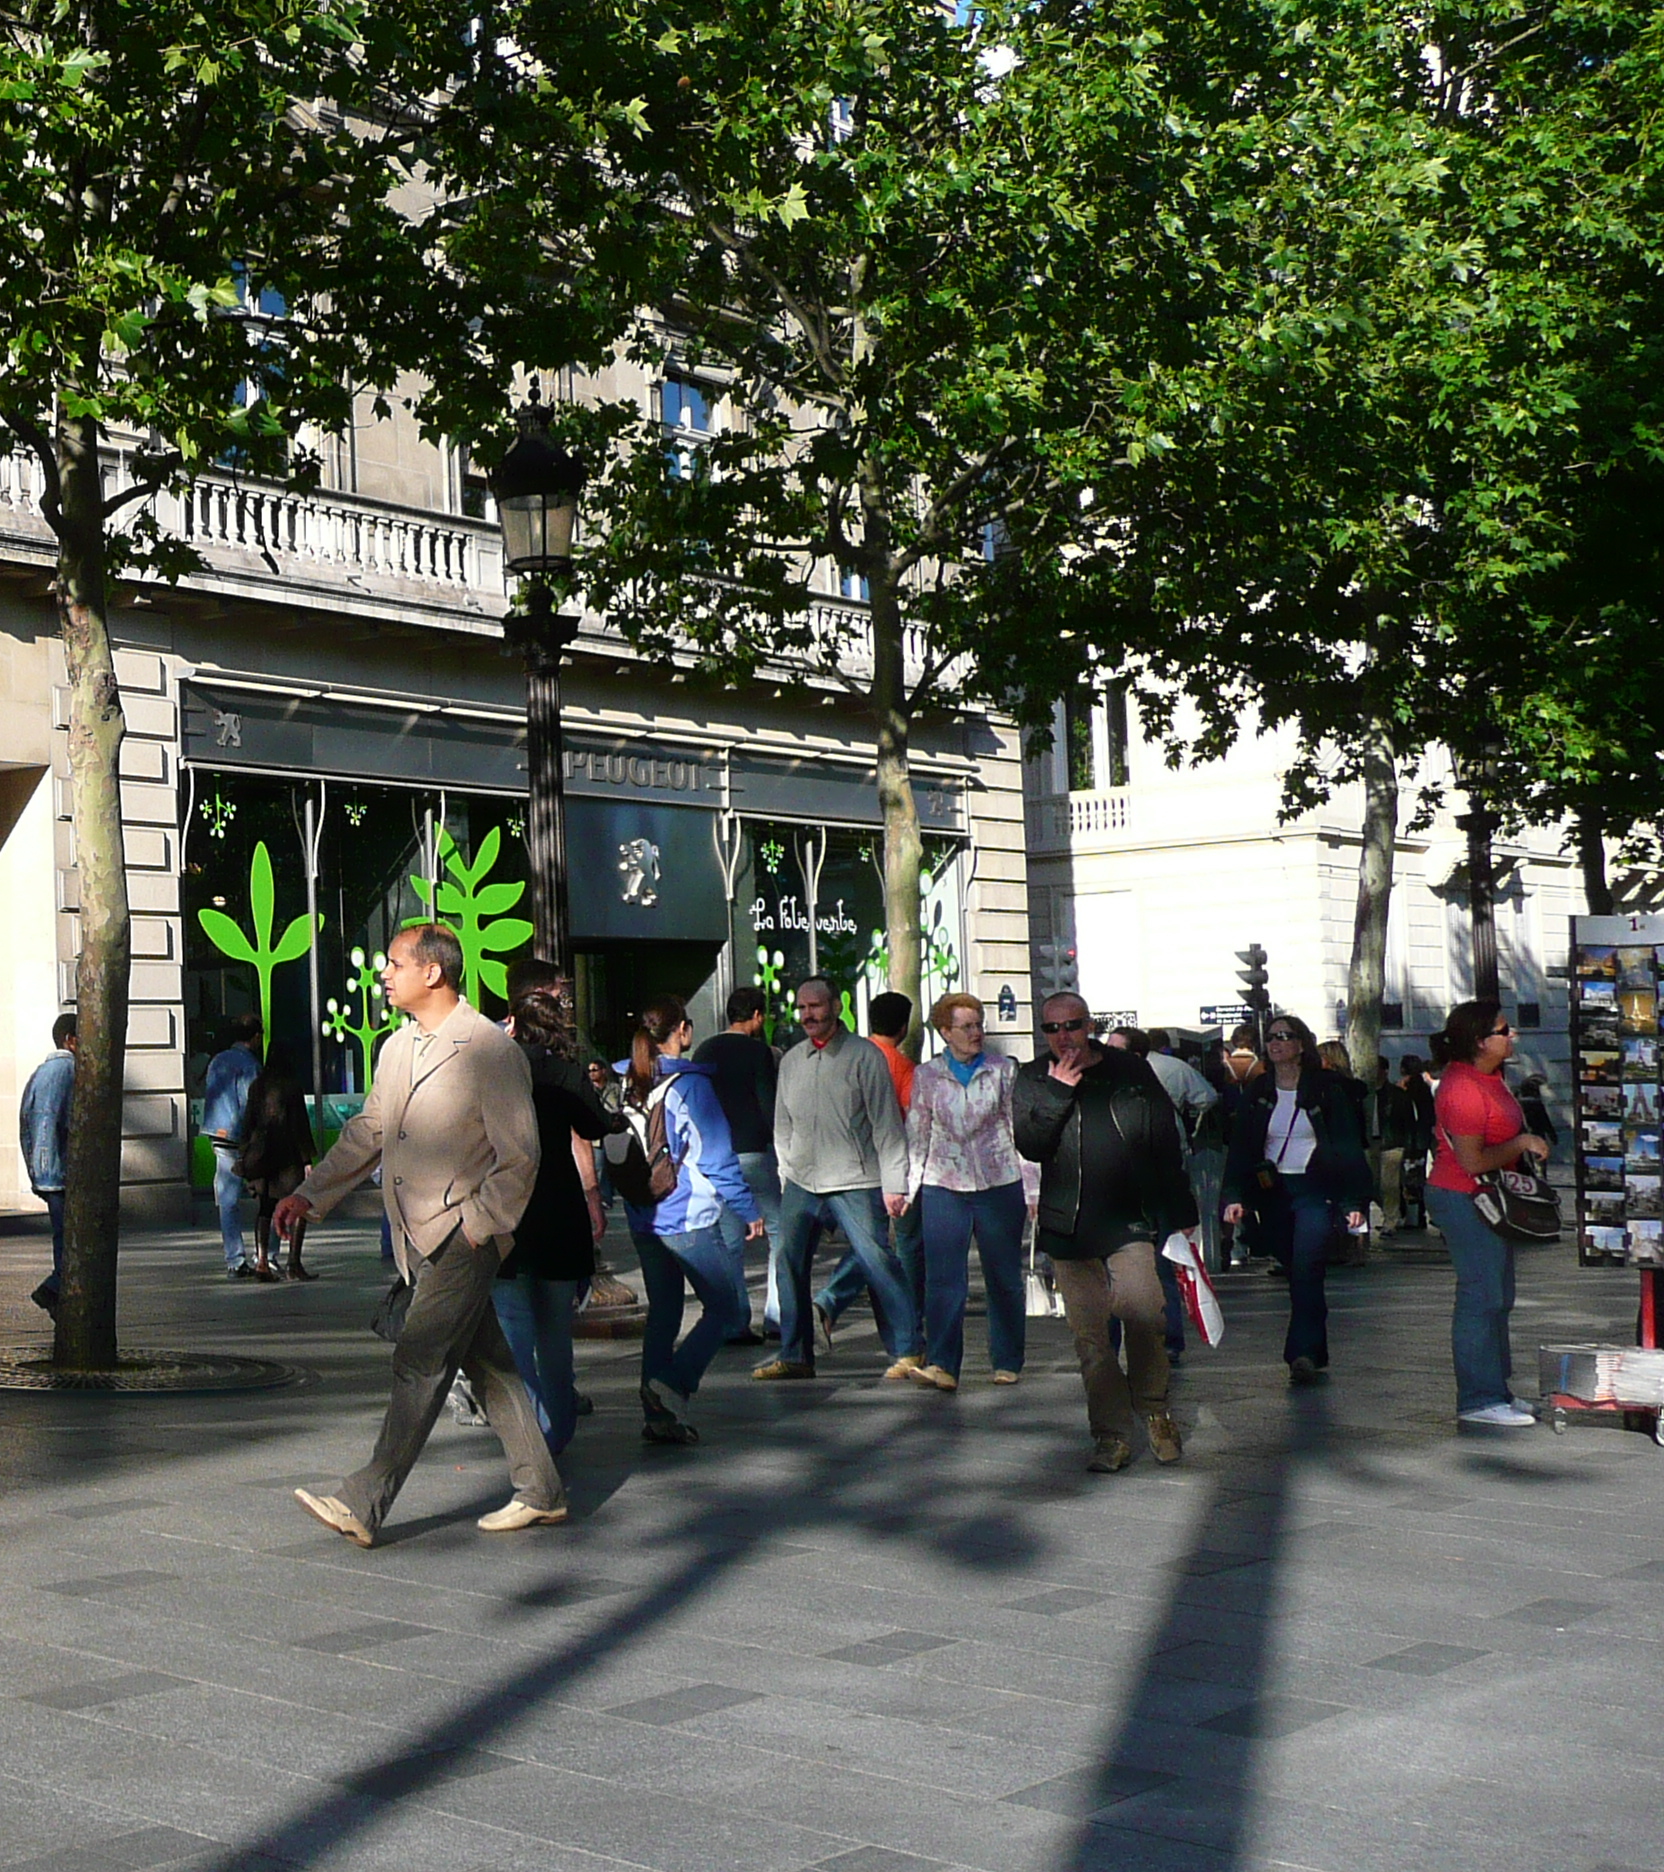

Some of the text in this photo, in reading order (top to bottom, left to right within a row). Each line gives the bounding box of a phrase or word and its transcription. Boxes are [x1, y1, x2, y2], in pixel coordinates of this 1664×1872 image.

[562, 751, 701, 792] PEUGEOT
[748, 897, 775, 932] La
[815, 898, 858, 935] verte
